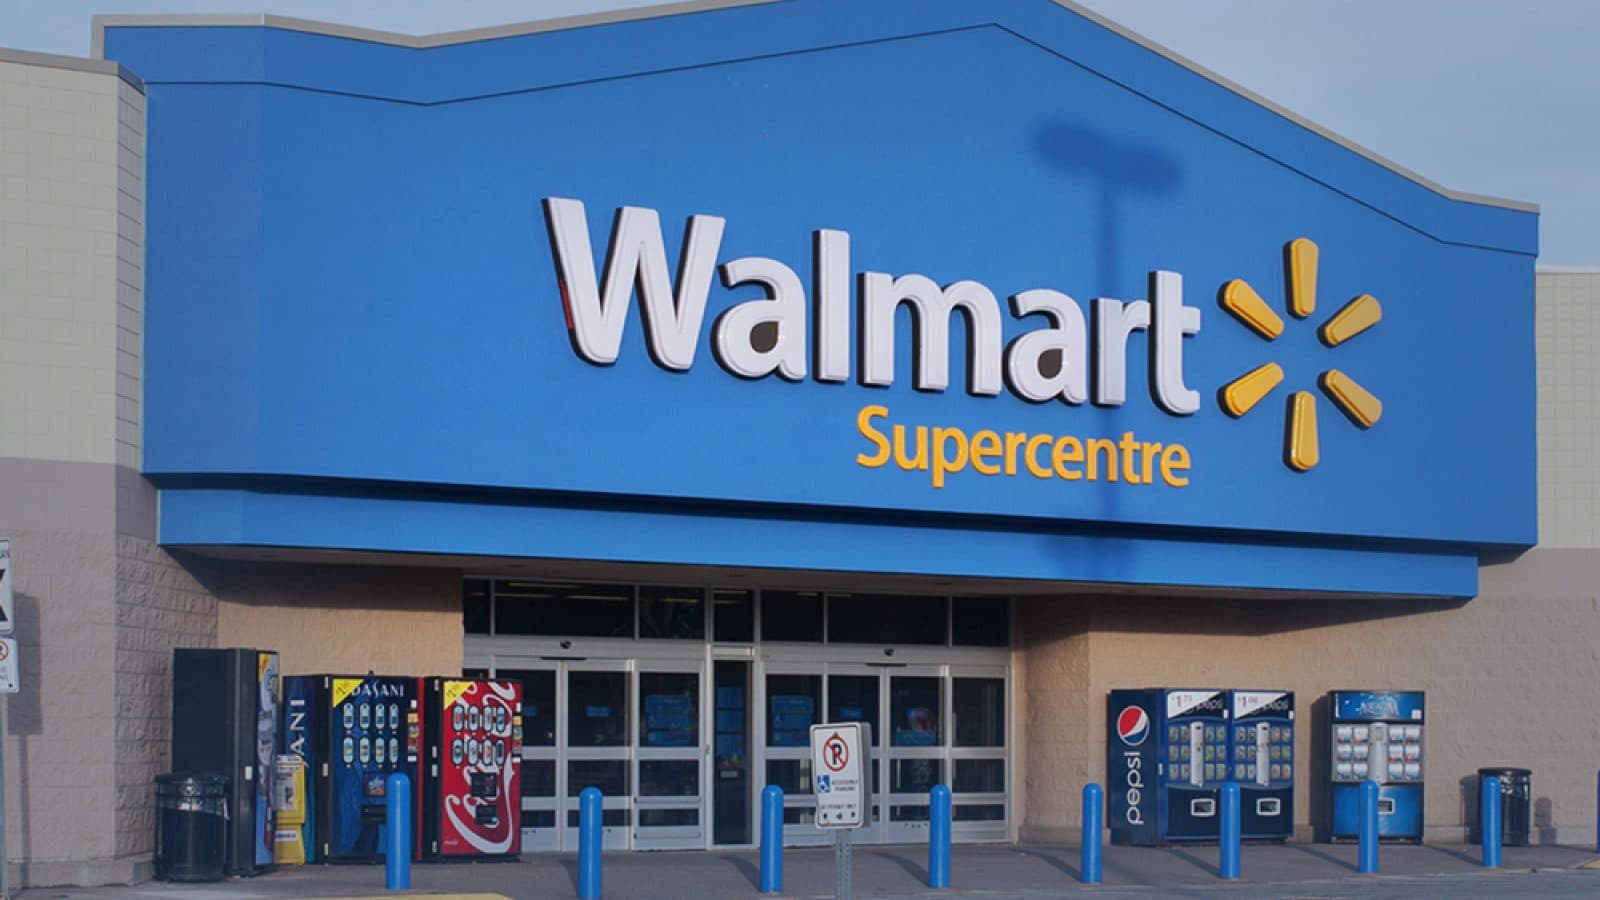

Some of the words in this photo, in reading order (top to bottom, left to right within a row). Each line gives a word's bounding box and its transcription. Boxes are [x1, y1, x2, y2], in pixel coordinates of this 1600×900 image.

[543, 197, 1201, 415] Walmart
[856, 405, 1192, 488] Supercentre
[1124, 751, 1145, 825] pepsi
